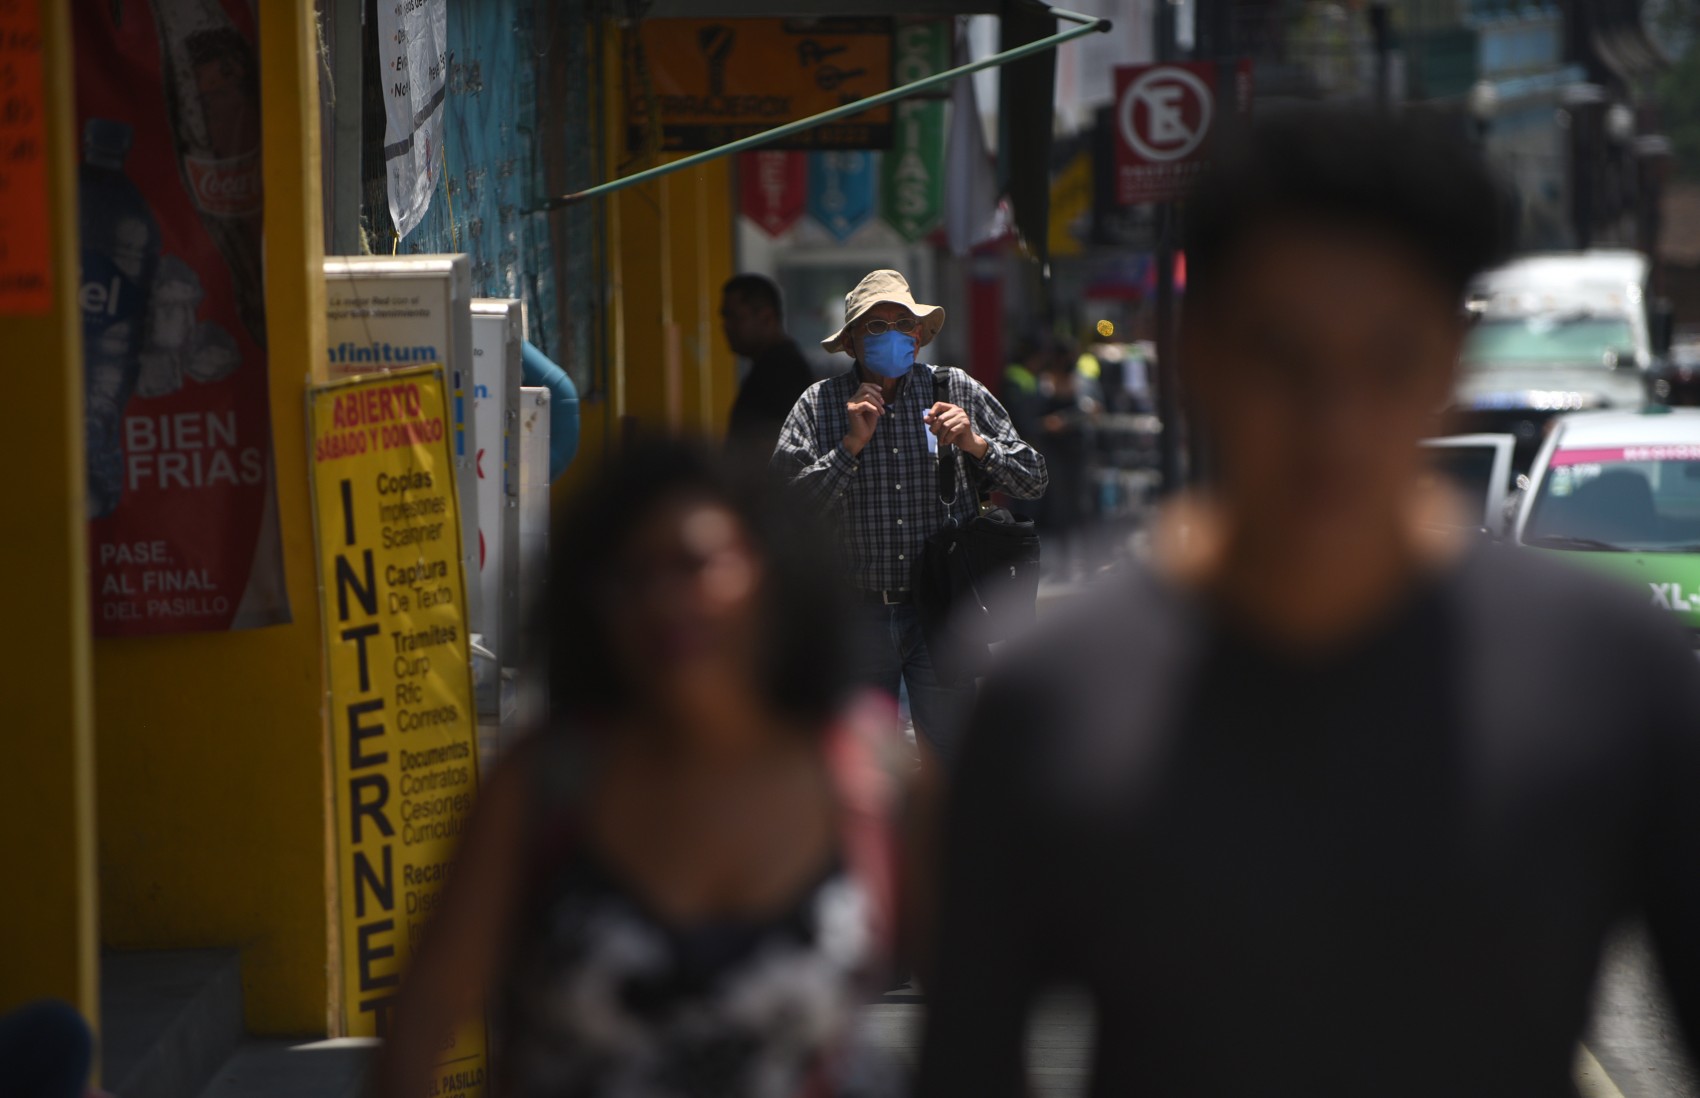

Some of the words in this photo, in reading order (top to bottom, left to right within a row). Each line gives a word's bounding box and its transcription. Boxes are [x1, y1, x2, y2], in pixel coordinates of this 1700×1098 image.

[79, 276, 121, 316] el
[327, 342, 437, 362] nfinitum
[333, 383, 421, 430] ABIERTO
[125, 411, 237, 452] BIEN
[369, 427, 379, 451] Y
[127, 447, 262, 491] FRIAS
[377, 471, 432, 496] Copias
[101, 573, 136, 595] AL
[142, 569, 217, 592] FINAL
[386, 560, 447, 589] Captura
[103, 600, 142, 621] DEL
[146, 596, 229, 617] PASILLO
[388, 592, 409, 615] De
[413, 586, 453, 610] Texto
[1648, 582, 1700, 611] XL-
[393, 655, 429, 679] Curp
[397, 705, 457, 733] Correos
[400, 742, 469, 771] Documentos
[400, 766, 469, 796] Contratos
[401, 793, 472, 822] Cesiones
[402, 815, 469, 846] Curriculu
[405, 889, 443, 915] Dise
